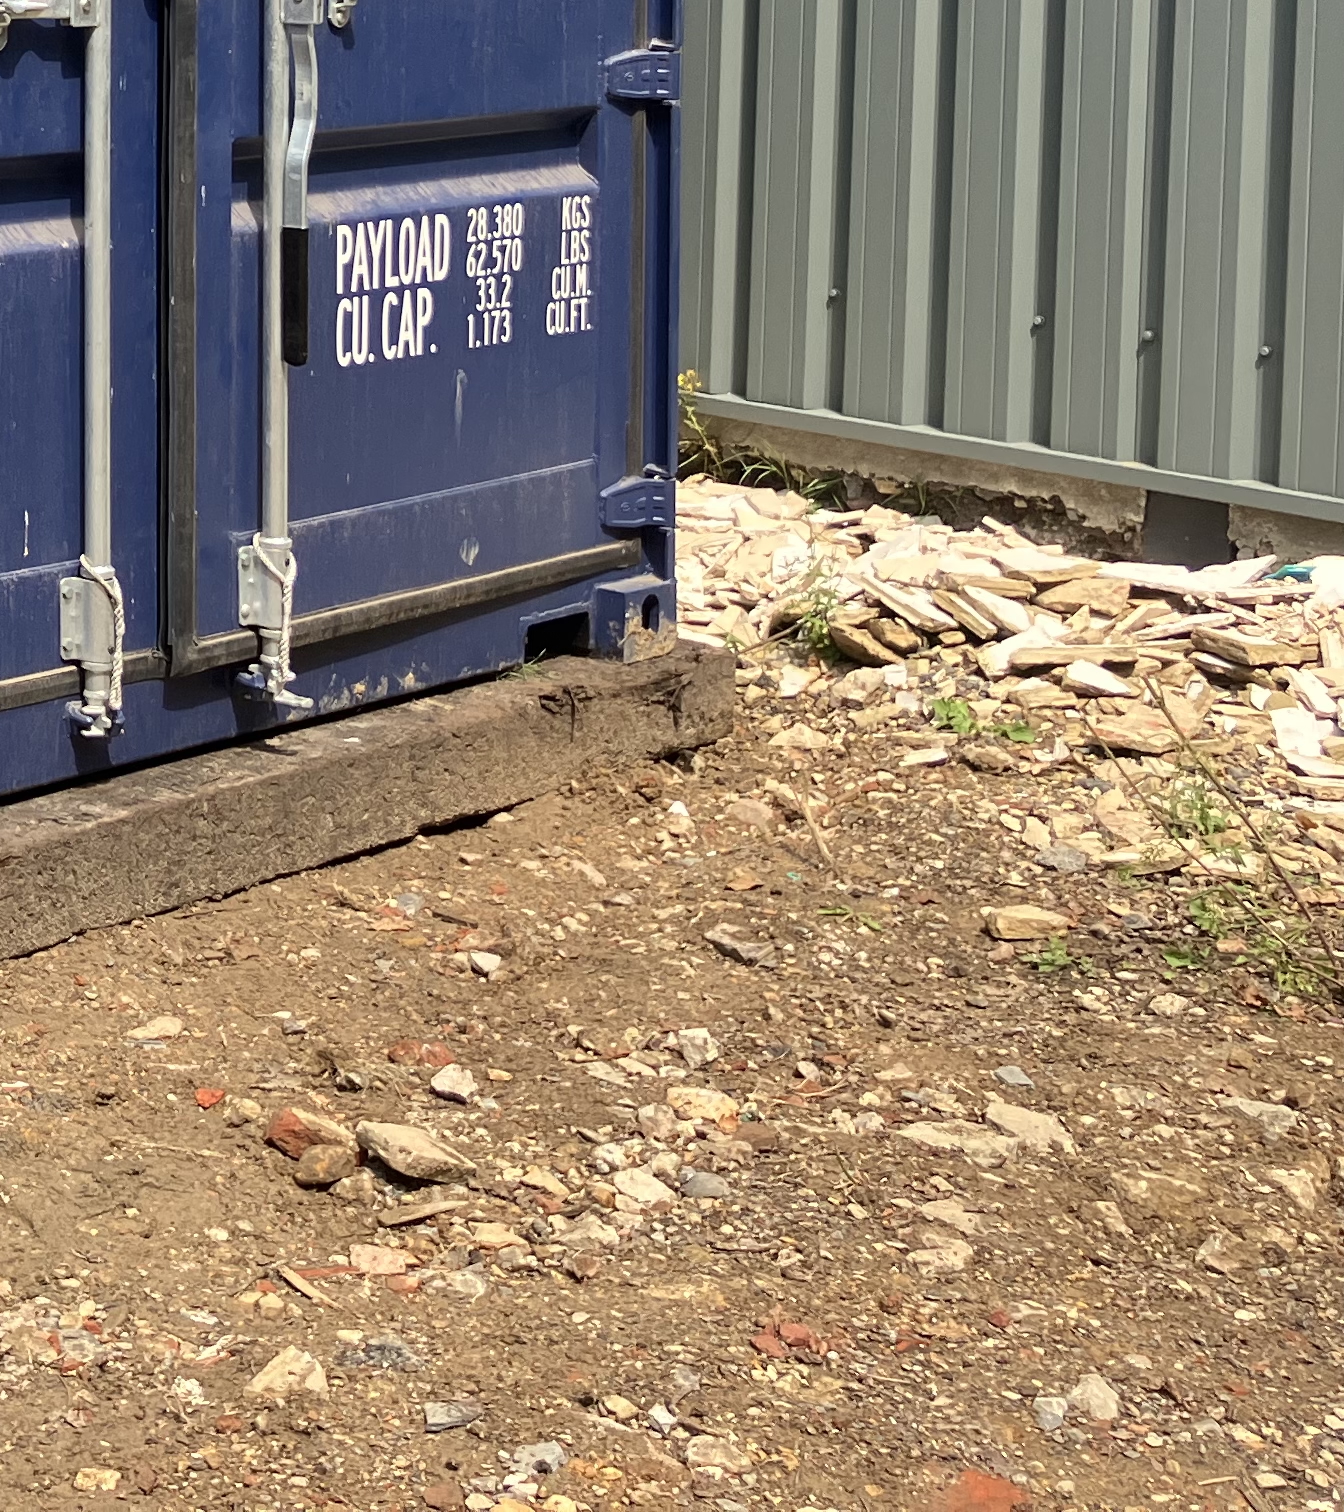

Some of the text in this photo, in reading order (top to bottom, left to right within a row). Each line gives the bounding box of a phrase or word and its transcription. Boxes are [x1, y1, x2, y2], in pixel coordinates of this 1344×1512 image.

[336, 214, 451, 295] PAYLOAD
[561, 195, 591, 231] KGS
[560, 229, 590, 265] LBS
[335, 263, 592, 367] CU. CAP. 33.2 CU.M.
[545, 297, 592, 336] CU.FT.
